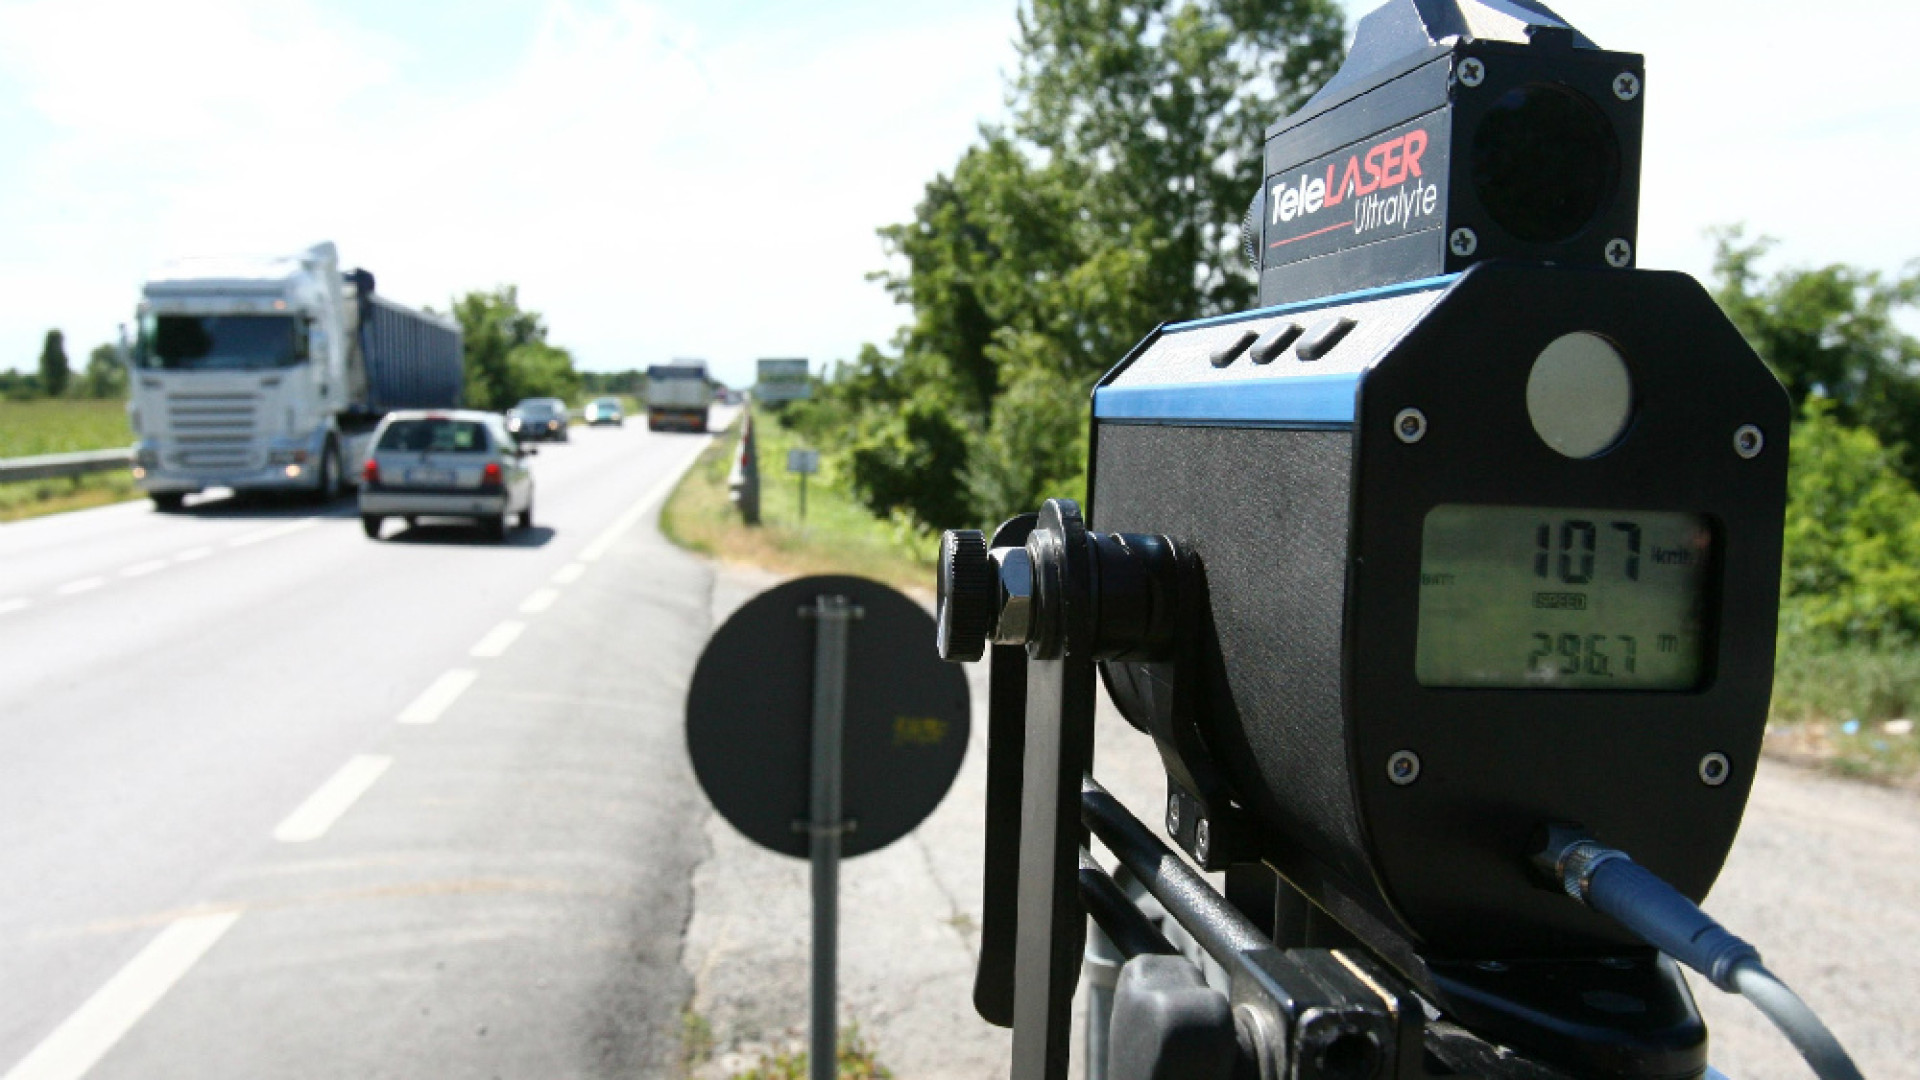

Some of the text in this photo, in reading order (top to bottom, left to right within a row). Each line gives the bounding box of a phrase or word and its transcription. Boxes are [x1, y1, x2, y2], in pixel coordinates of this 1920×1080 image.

[1271, 129, 1428, 225] TeleLASER
[1355, 178, 1437, 235] Ultralyte
[1534, 519, 1642, 583] 107
[1536, 593, 1586, 610] SPEED
[1657, 634, 1678, 653] m
